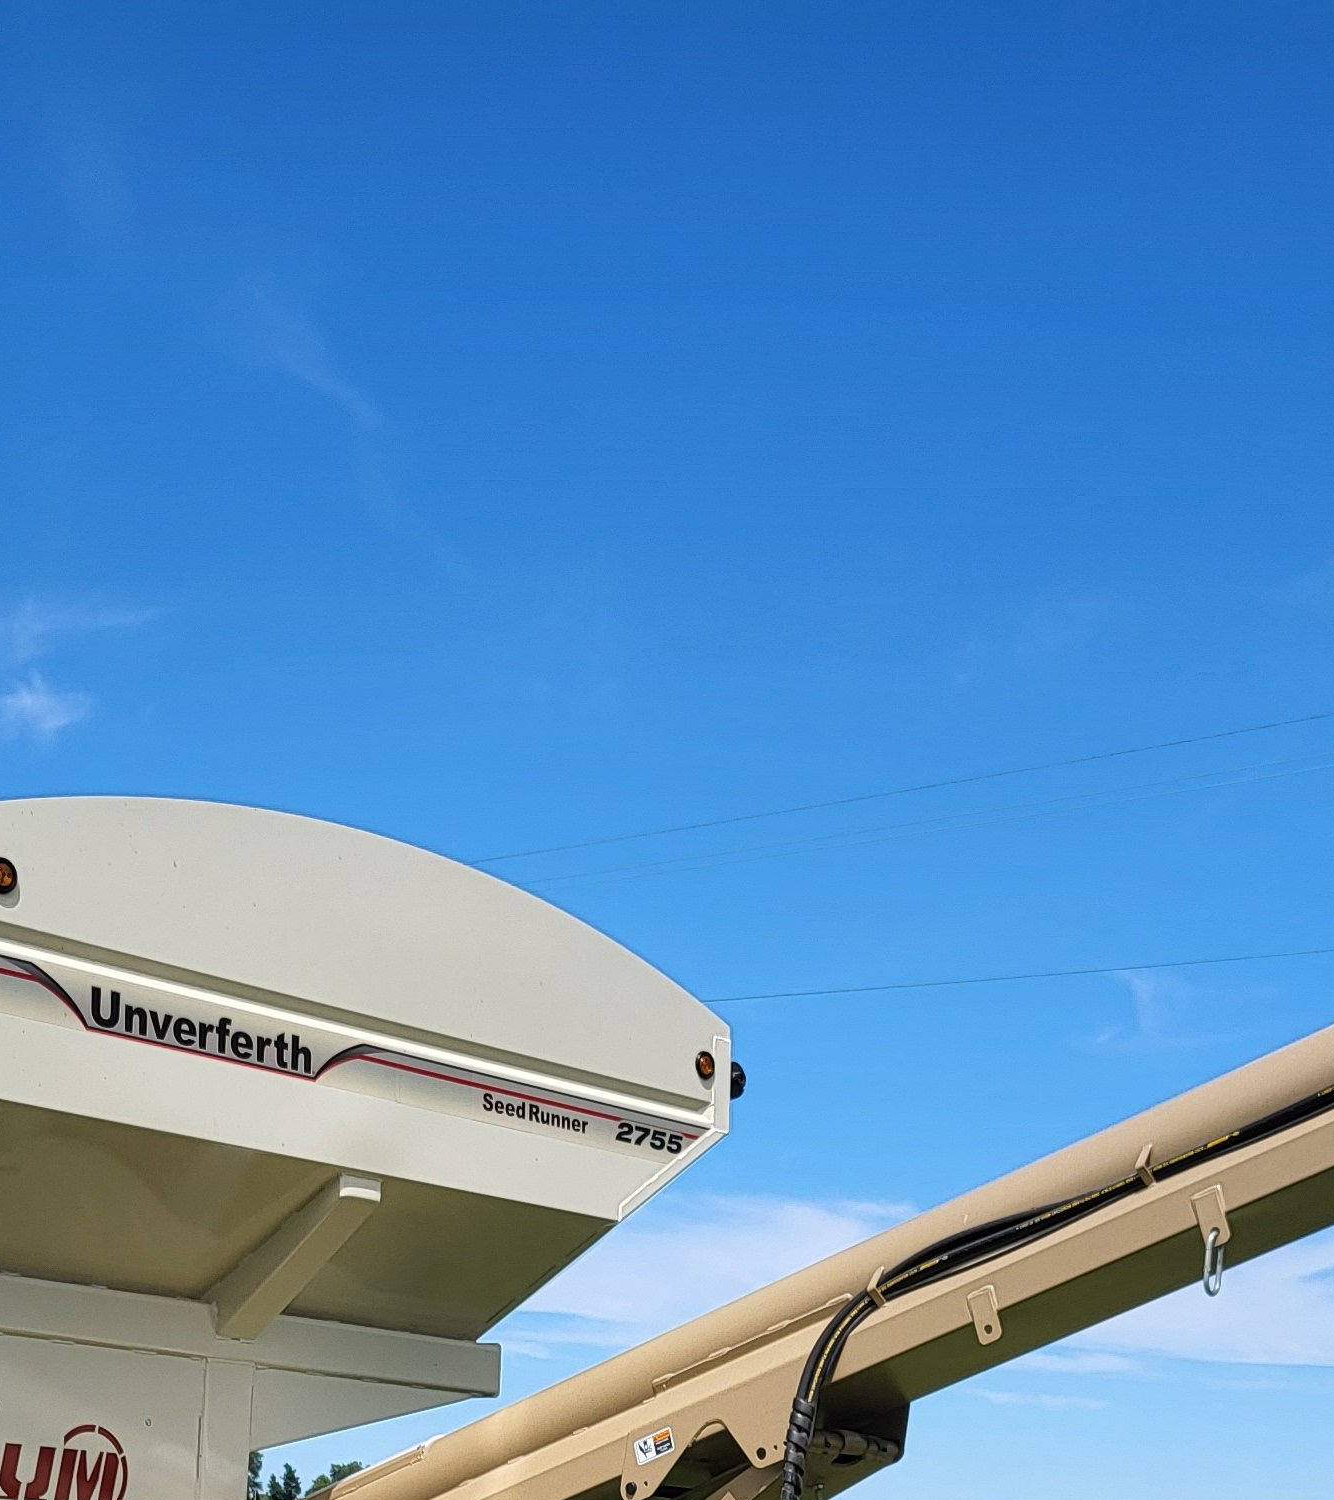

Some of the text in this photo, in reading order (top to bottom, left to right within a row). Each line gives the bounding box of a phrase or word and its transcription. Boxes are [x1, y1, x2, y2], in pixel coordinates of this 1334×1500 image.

[91, 985, 312, 1074] Unverferth
[483, 1093, 684, 1155] Seed Runner 2755
